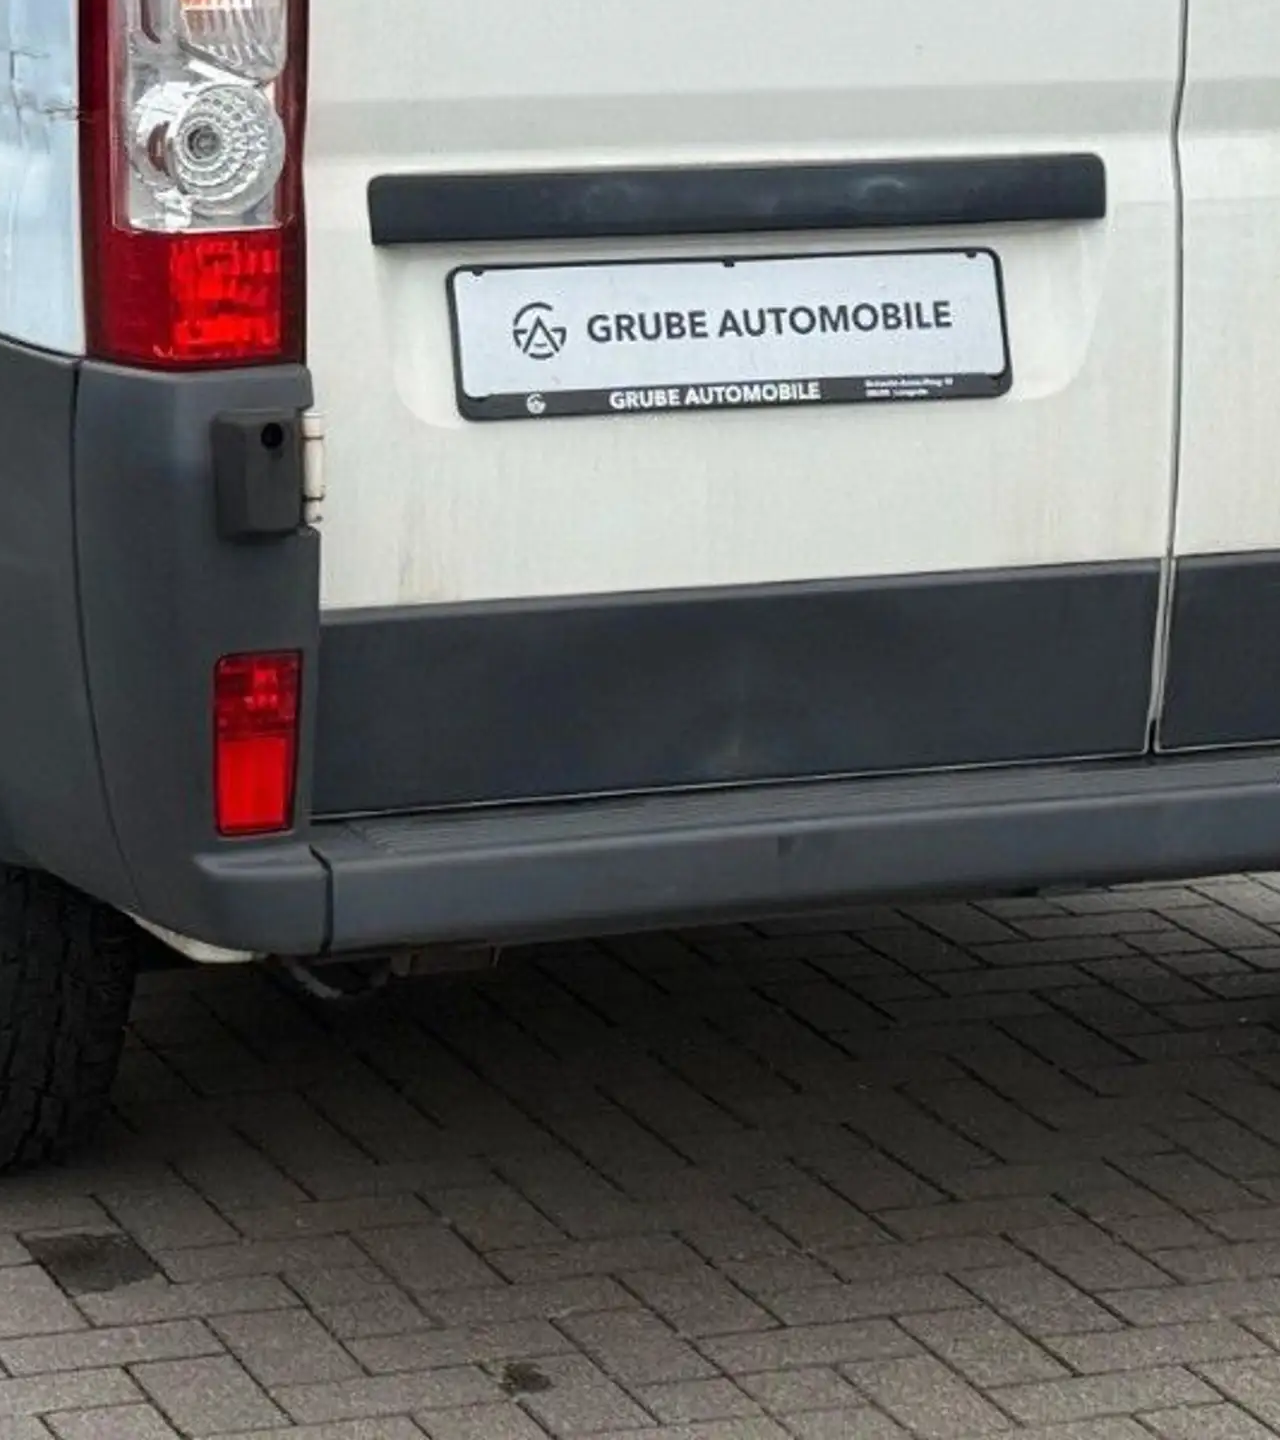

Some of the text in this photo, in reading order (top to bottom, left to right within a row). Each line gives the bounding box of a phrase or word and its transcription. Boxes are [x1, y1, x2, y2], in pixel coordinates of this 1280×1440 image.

[586, 300, 953, 343] GRUBE AUTOMOBILE
[609, 381, 821, 410] GRUBE AUTOMOBILE
